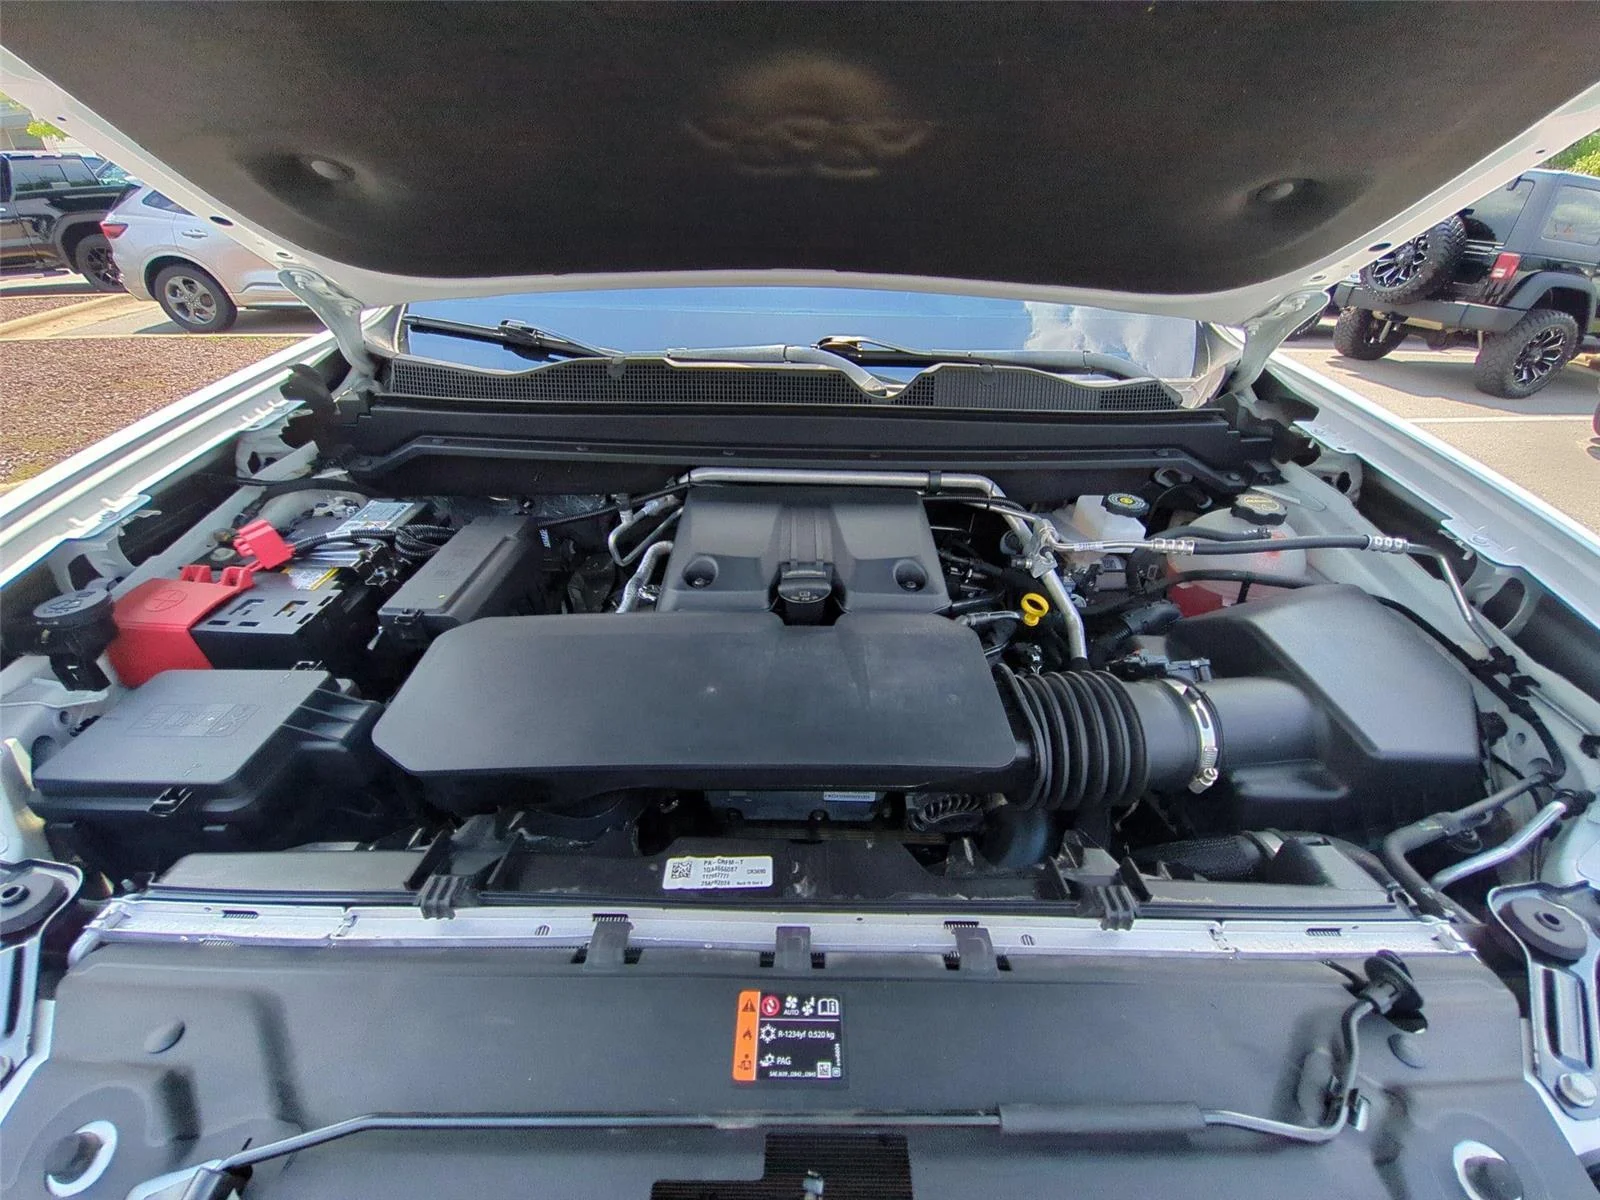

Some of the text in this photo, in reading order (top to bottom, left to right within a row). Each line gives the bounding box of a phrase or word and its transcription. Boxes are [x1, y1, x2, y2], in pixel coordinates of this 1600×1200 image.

[777, 1030, 835, 1040] R-1234yf 0.520 kg
[776, 1057, 792, 1065] PAG
